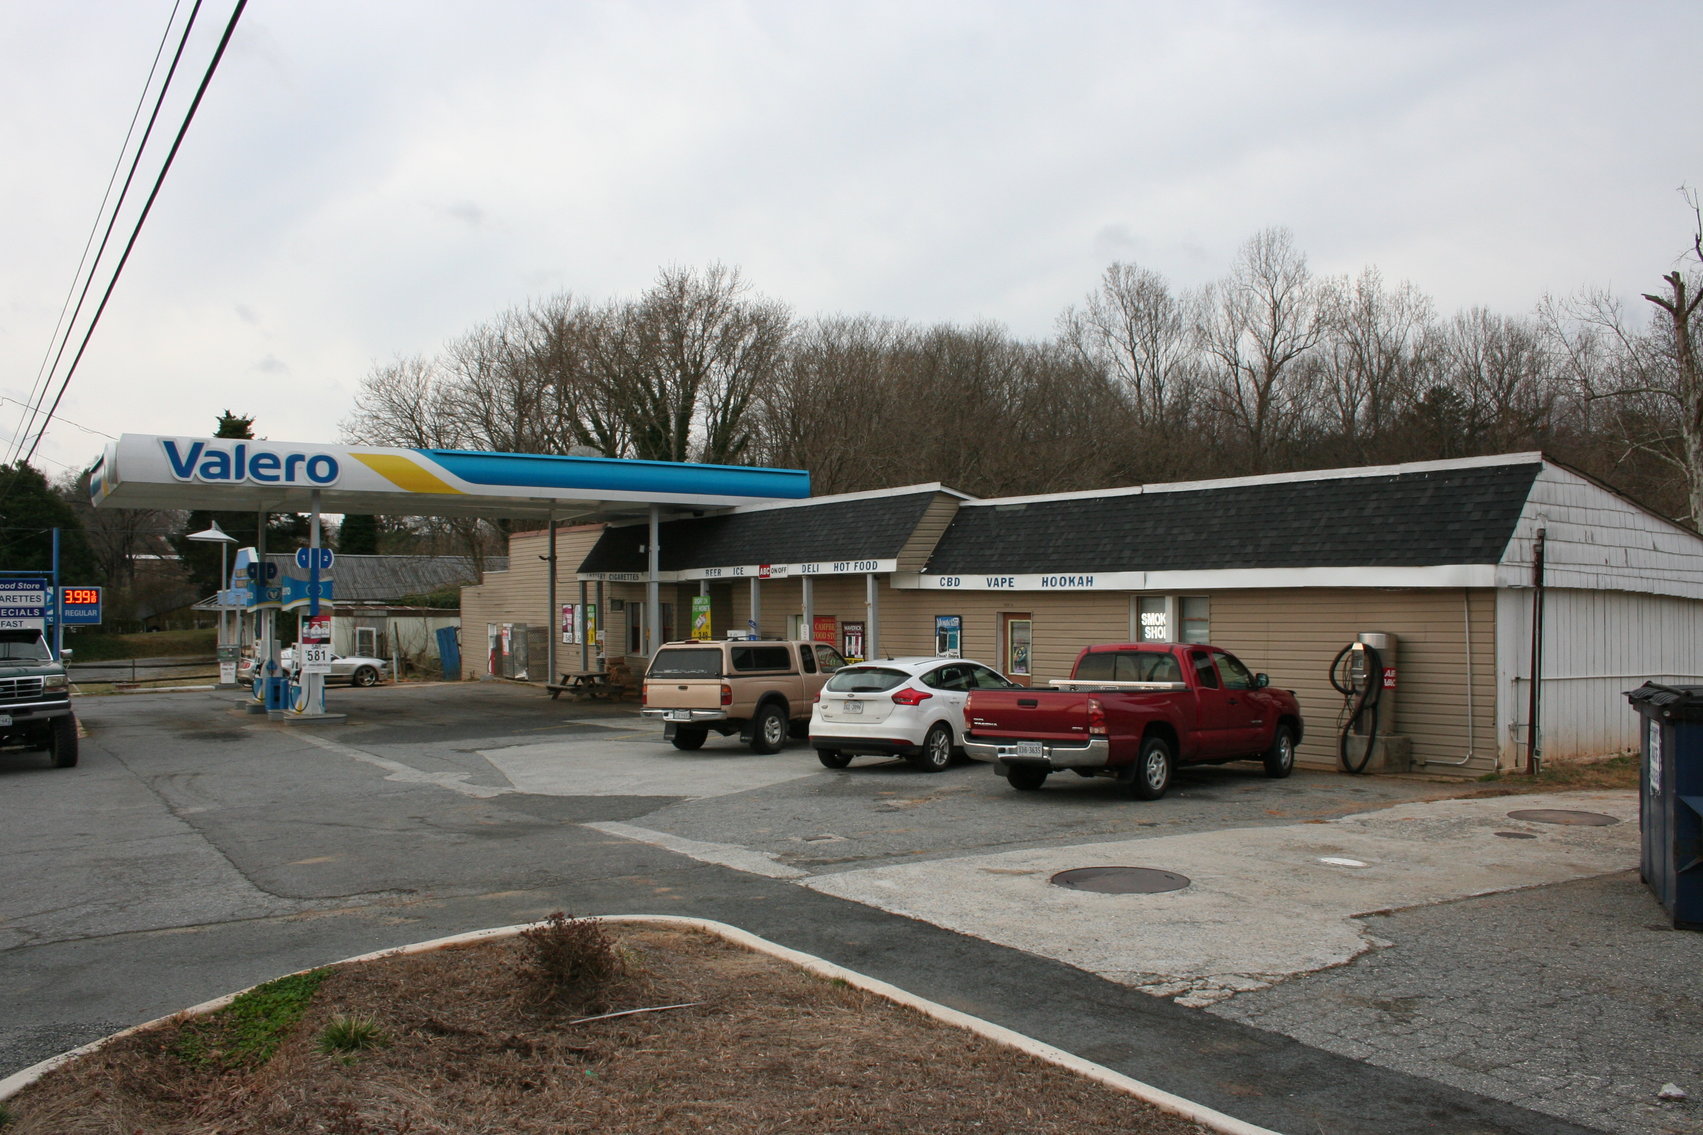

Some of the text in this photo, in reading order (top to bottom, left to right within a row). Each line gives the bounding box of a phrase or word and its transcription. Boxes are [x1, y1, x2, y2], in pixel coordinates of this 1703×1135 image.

[163, 441, 339, 484] Valero
[733, 567, 744, 576] ICE
[802, 564, 820, 573] DELI
[834, 561, 878, 572] HOT FOOD
[609, 573, 640, 581] CIGARETTES
[705, 569, 722, 577] BEER
[17, 582, 40, 590] Store
[939, 577, 961, 587] CBD
[986, 577, 1015, 588] VAPE
[1041, 576, 1094, 588] HOOKAH
[64, 590, 91, 604] 3.99
